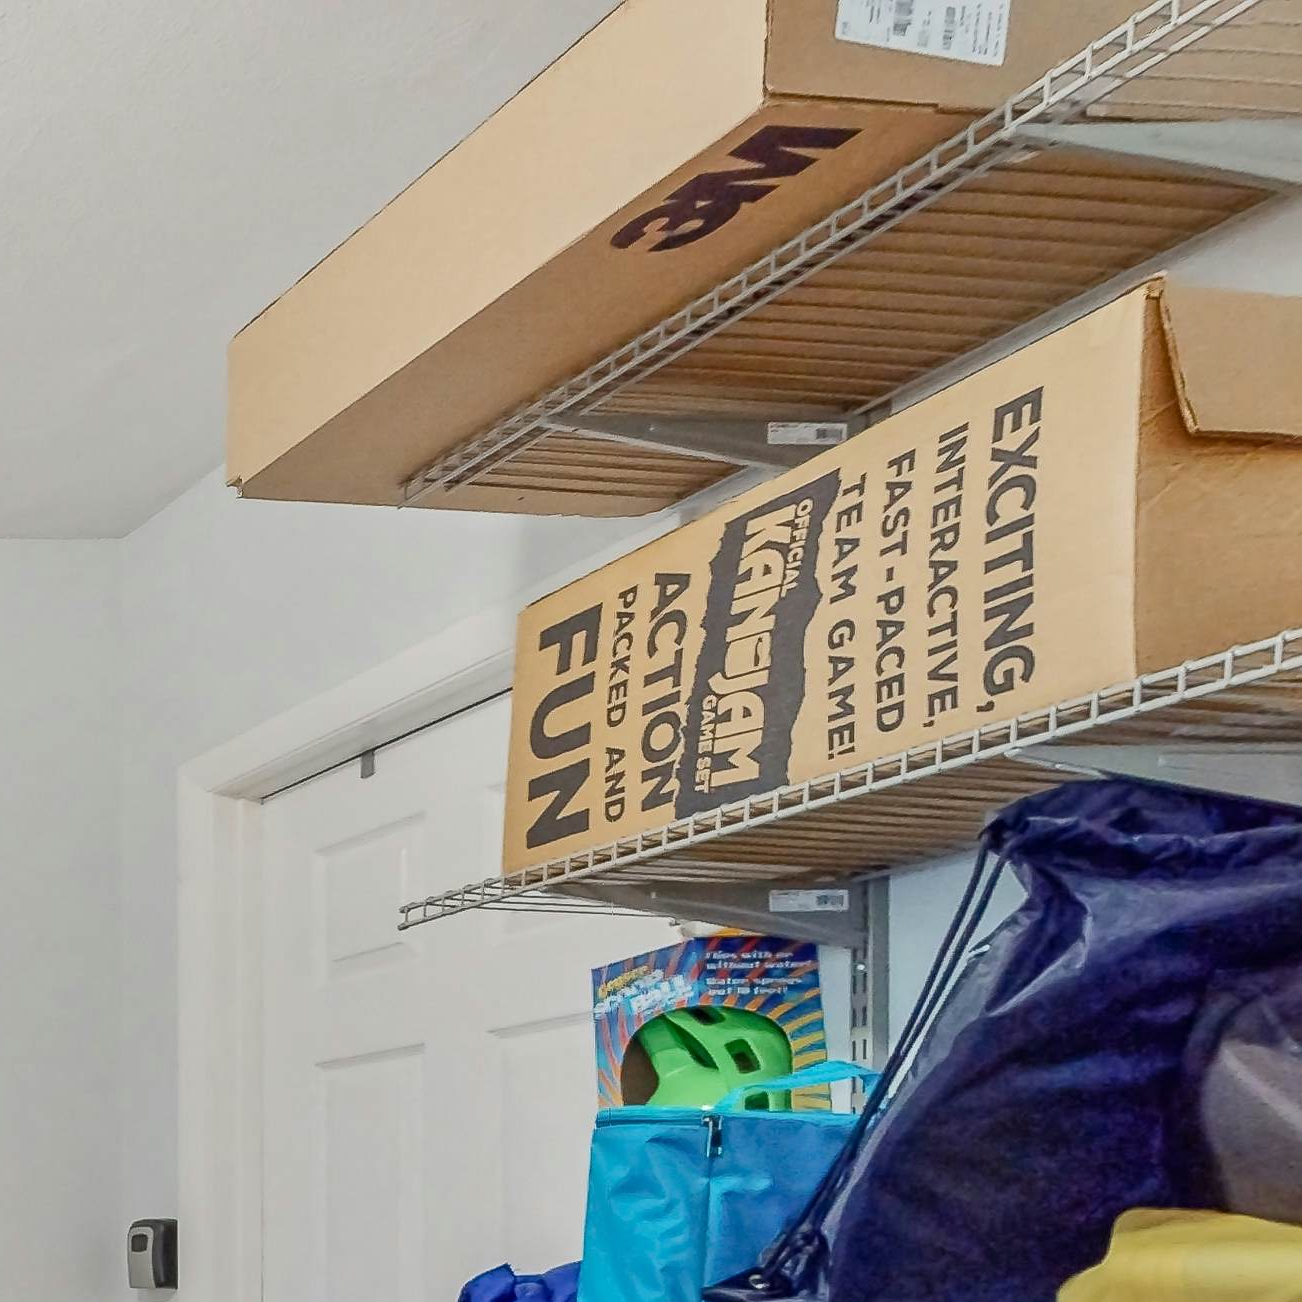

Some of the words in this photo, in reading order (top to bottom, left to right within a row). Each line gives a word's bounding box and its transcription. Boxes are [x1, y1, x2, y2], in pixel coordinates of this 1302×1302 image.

[610, 124, 865, 253] 3M
[781, 498, 813, 597] OFFICIAL
[828, 473, 868, 605] TEAM
[923, 421, 970, 729] INTERACTIVE,
[975, 386, 1044, 714] EXCITING,
[606, 583, 639, 728] PACKED
[639, 571, 692, 813] ACTION
[698, 694, 717, 753] GAME
[826, 619, 857, 762] GAME!
[525, 600, 603, 850] FUN
[604, 745, 628, 824] AND
[695, 754, 712, 793] SET
